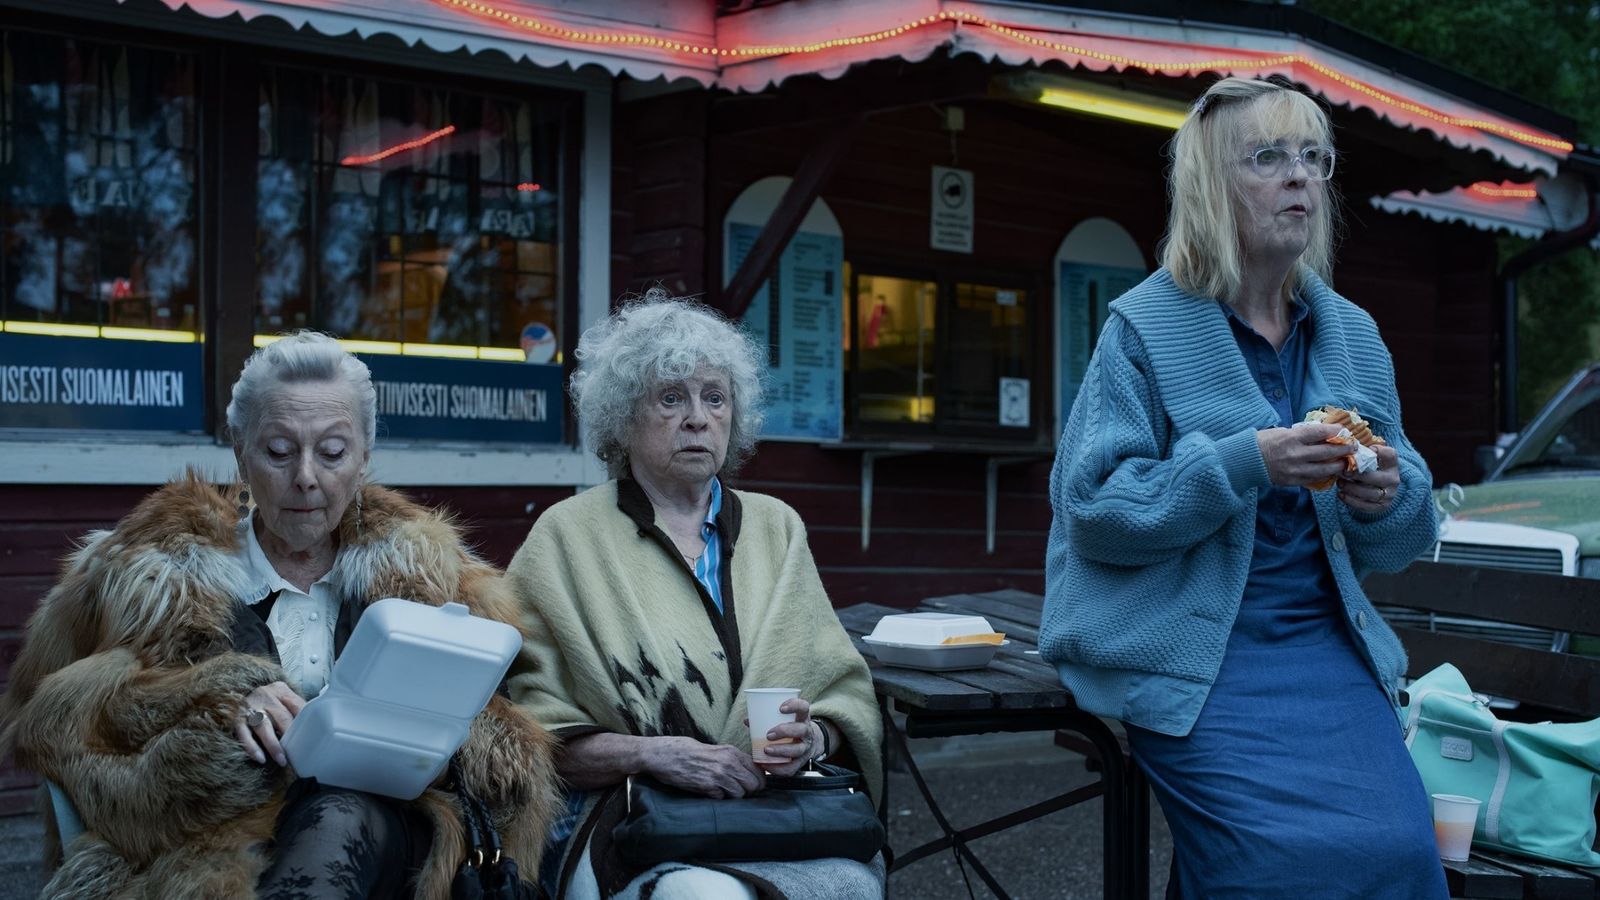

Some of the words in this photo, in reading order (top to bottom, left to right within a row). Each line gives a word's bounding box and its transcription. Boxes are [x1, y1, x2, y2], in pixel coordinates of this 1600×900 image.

[0, 365, 57, 404] ISESTI
[61, 367, 184, 406] SUOMALAINEN
[451, 384, 547, 422] SUOMALAINEN
